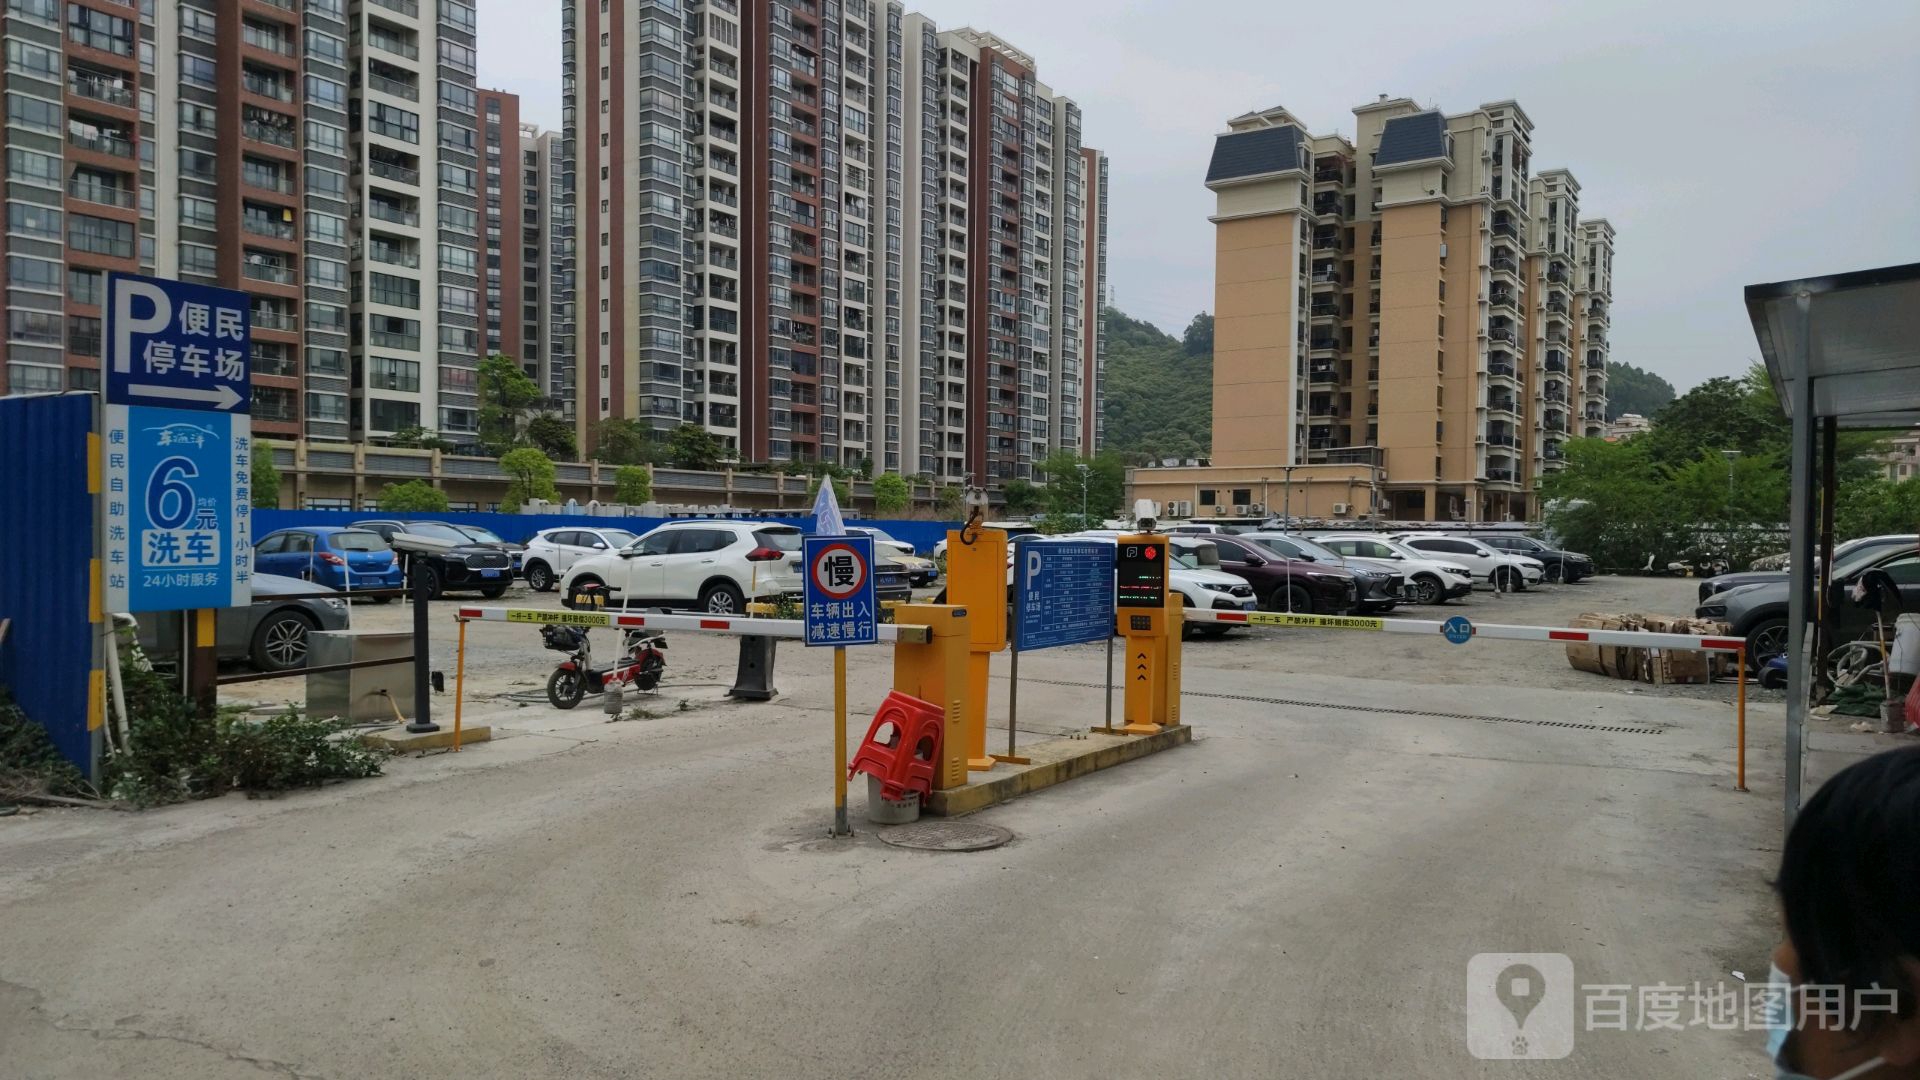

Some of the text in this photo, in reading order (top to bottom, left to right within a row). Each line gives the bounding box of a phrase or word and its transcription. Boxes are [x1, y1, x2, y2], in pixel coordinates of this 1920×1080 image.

[114, 278, 172, 374] P
[179, 301, 244, 342] 便民
[143, 339, 245, 382] 停车场
[108, 429, 126, 589] 便民自助洗车站
[145, 455, 199, 531] 6
[234, 436, 249, 584] 洗车免费停1小时半
[195, 508, 219, 531] 元
[147, 532, 215, 564] 洗车
[143, 572, 219, 588] 24小时服务
[824, 555, 855, 587] 慢
[1026, 550, 1042, 590] P
[811, 601, 871, 620] 车辆出入
[1445, 621, 1470, 633] 入口
[811, 621, 871, 640] 减速慢行
